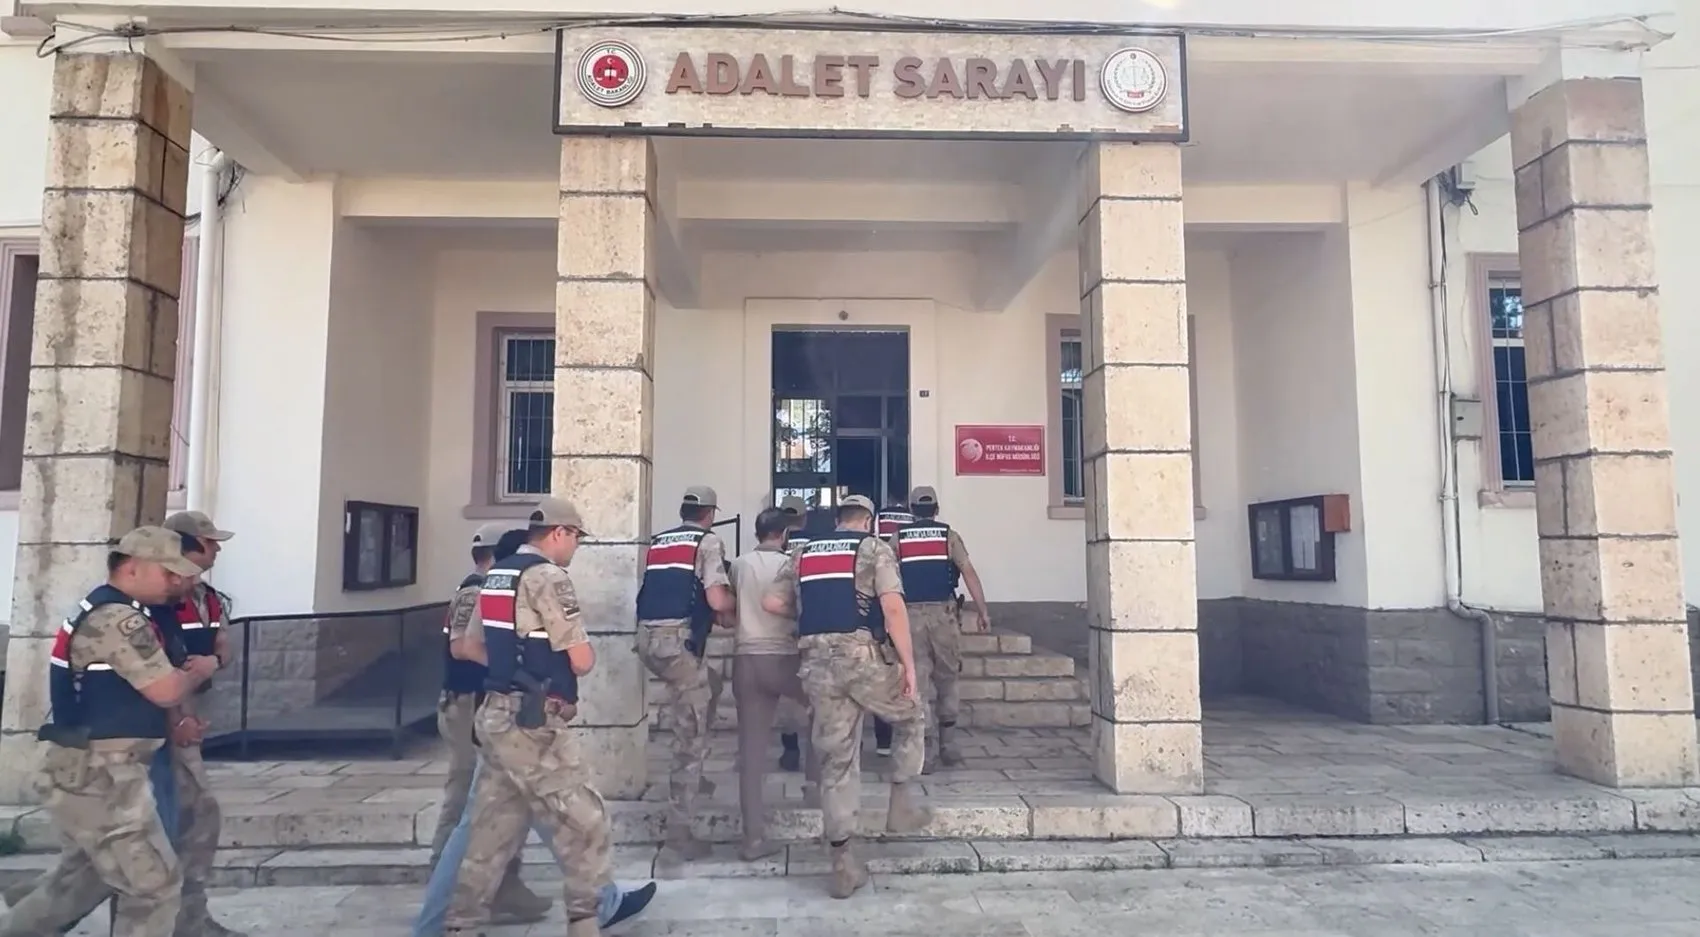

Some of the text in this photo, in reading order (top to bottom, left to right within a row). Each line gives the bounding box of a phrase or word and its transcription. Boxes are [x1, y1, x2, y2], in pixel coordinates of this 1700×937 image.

[666, 51, 880, 98] ADALET
[894, 56, 1087, 102] SARAYI
[904, 530, 942, 539] JANDARMA
[808, 542, 850, 553] JANDARMA
